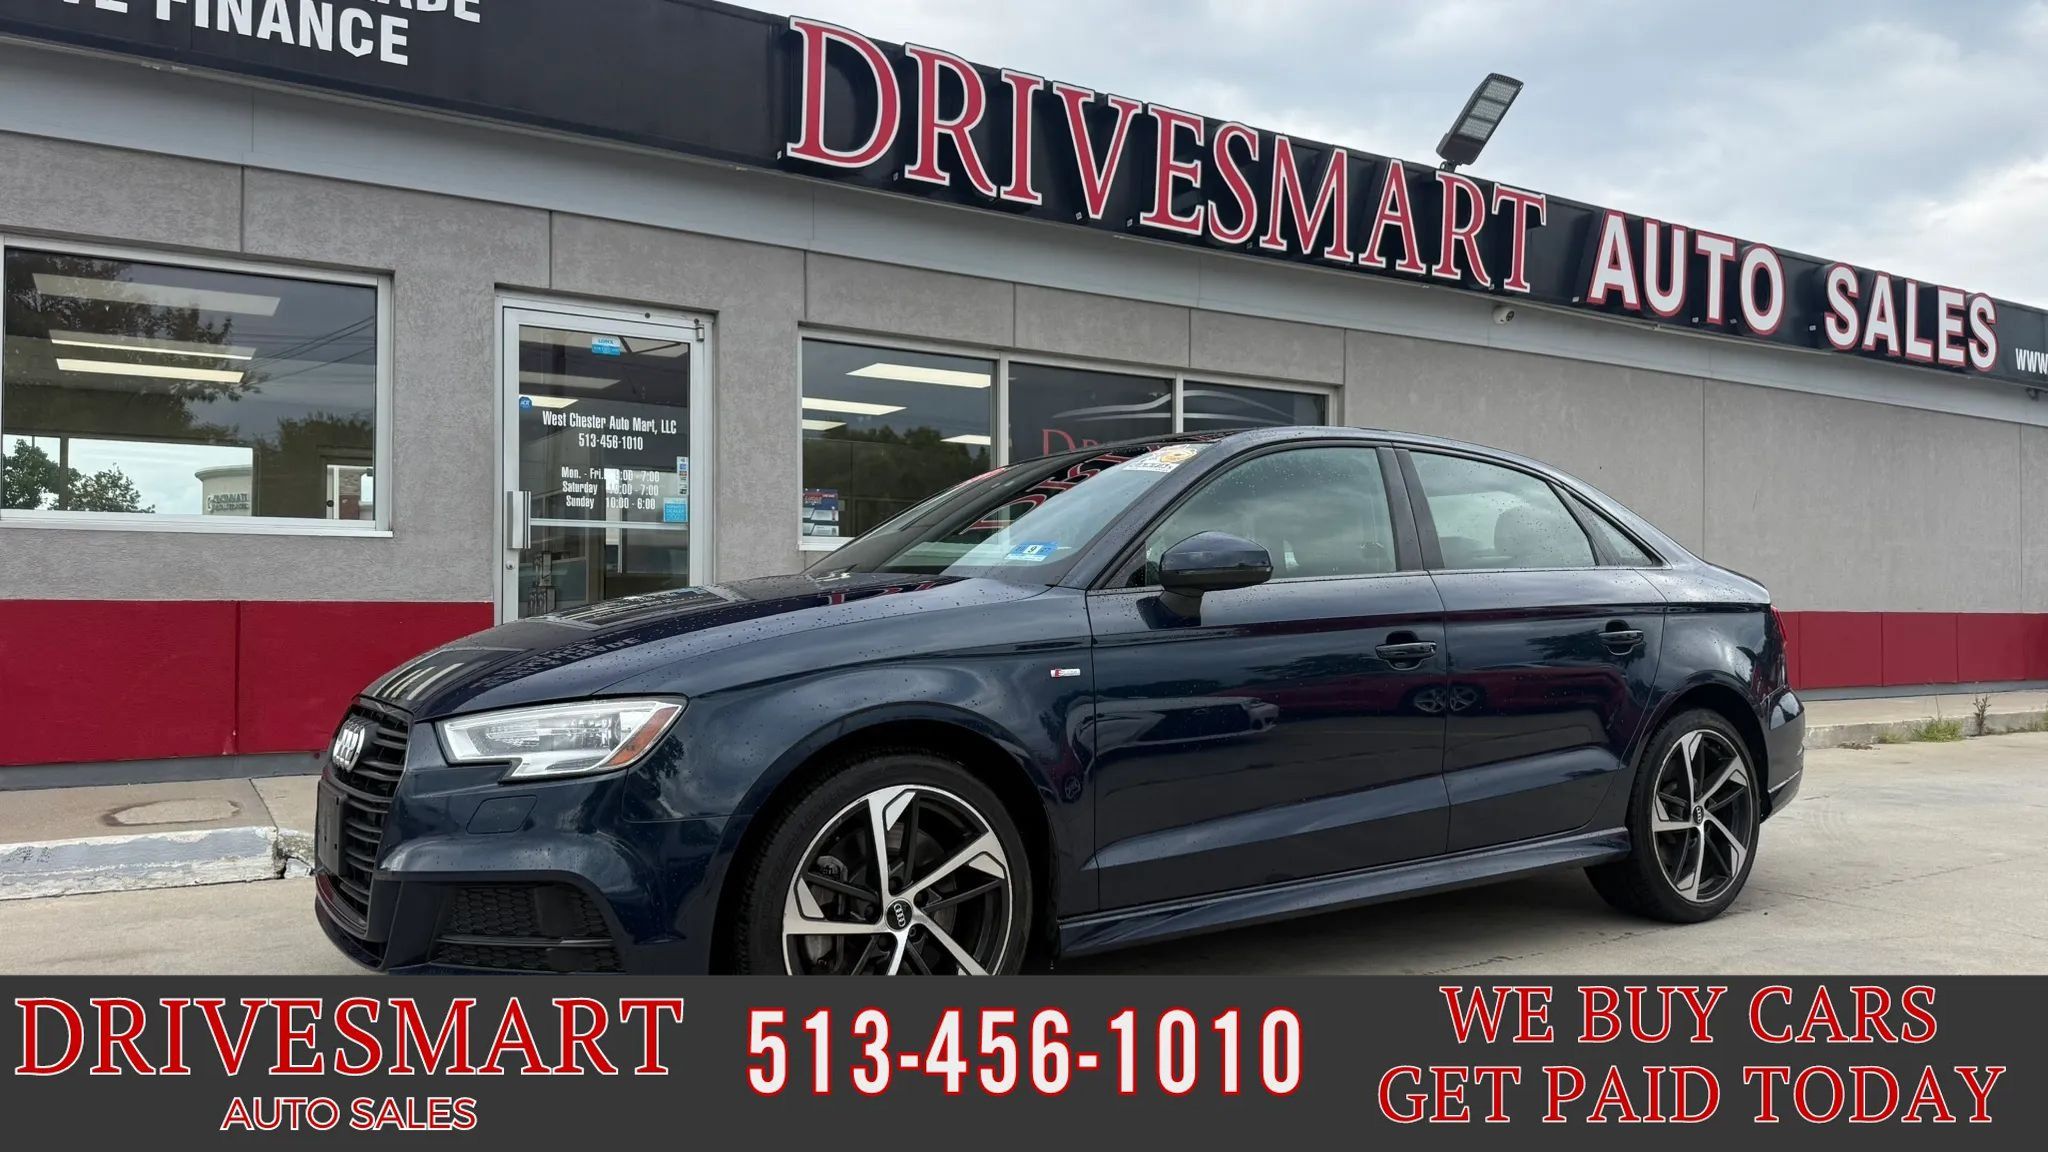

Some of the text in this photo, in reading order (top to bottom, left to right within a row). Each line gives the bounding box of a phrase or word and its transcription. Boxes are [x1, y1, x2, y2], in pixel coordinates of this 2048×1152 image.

[787, 15, 1546, 294] DRIVESMART
[1587, 209, 1998, 372] AUTO SALES
[542, 410, 677, 435] West Chester Auto Mart, LLC
[578, 433, 643, 451] 513-456-1010
[561, 466, 581, 479] Mon.
[590, 467, 604, 480] Fri.
[641, 470, 660, 482] 7:00
[562, 481, 598, 495] Saturday
[640, 484, 659, 496] 7:00
[566, 495, 594, 509] Sunday
[606, 496, 629, 509] 10:00
